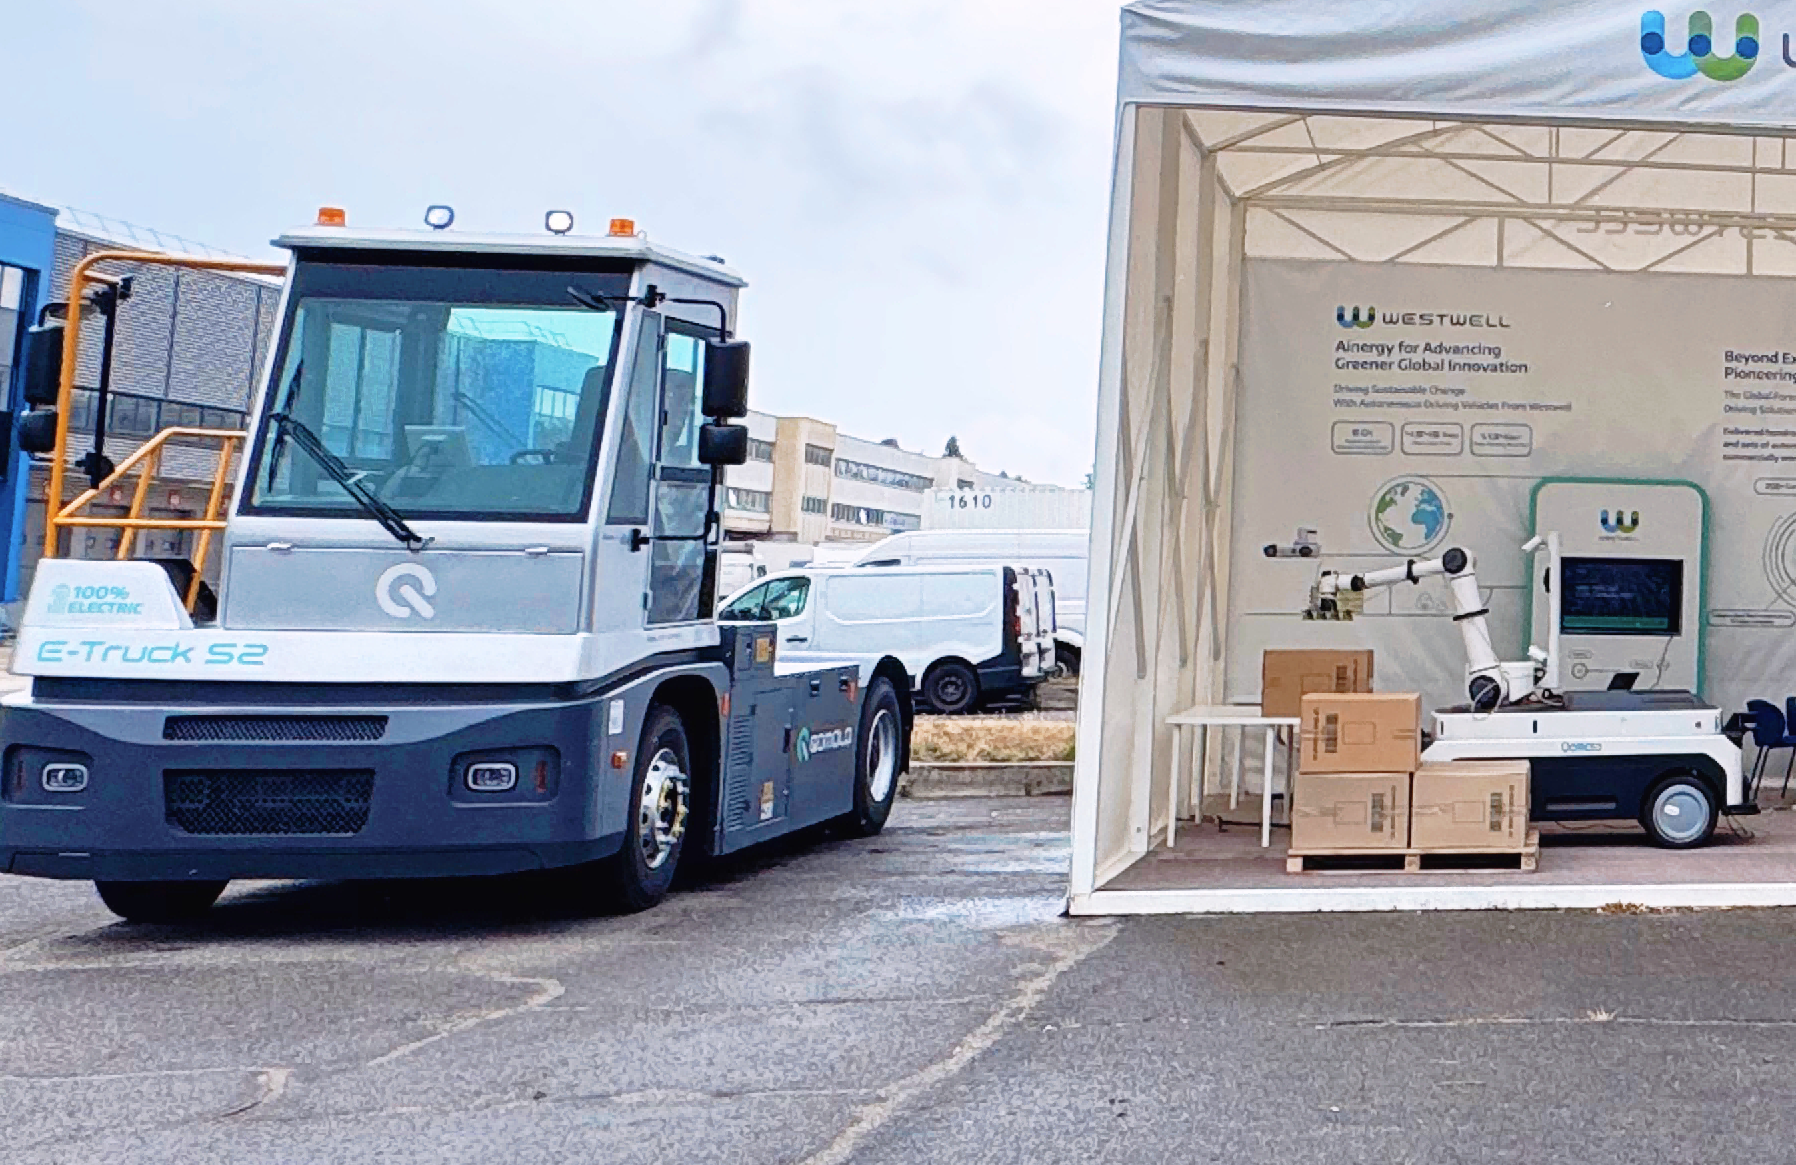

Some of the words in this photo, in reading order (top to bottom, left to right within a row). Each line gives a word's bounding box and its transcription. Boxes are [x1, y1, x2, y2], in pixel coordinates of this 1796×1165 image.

[1382, 312, 1512, 329] WESTWELL
[1398, 340, 1420, 354] for
[1422, 342, 1502, 359] Advancing
[1334, 357, 1395, 371] Greener
[1397, 358, 1445, 372] Global
[1448, 359, 1529, 374] Innovation
[1724, 350, 1780, 366] Beyond
[949, 494, 992, 509] 1610
[73, 585, 130, 600] 100%
[67, 601, 145, 615] ELECTRIC
[37, 640, 195, 664] E-Truck
[204, 642, 270, 666] S2
